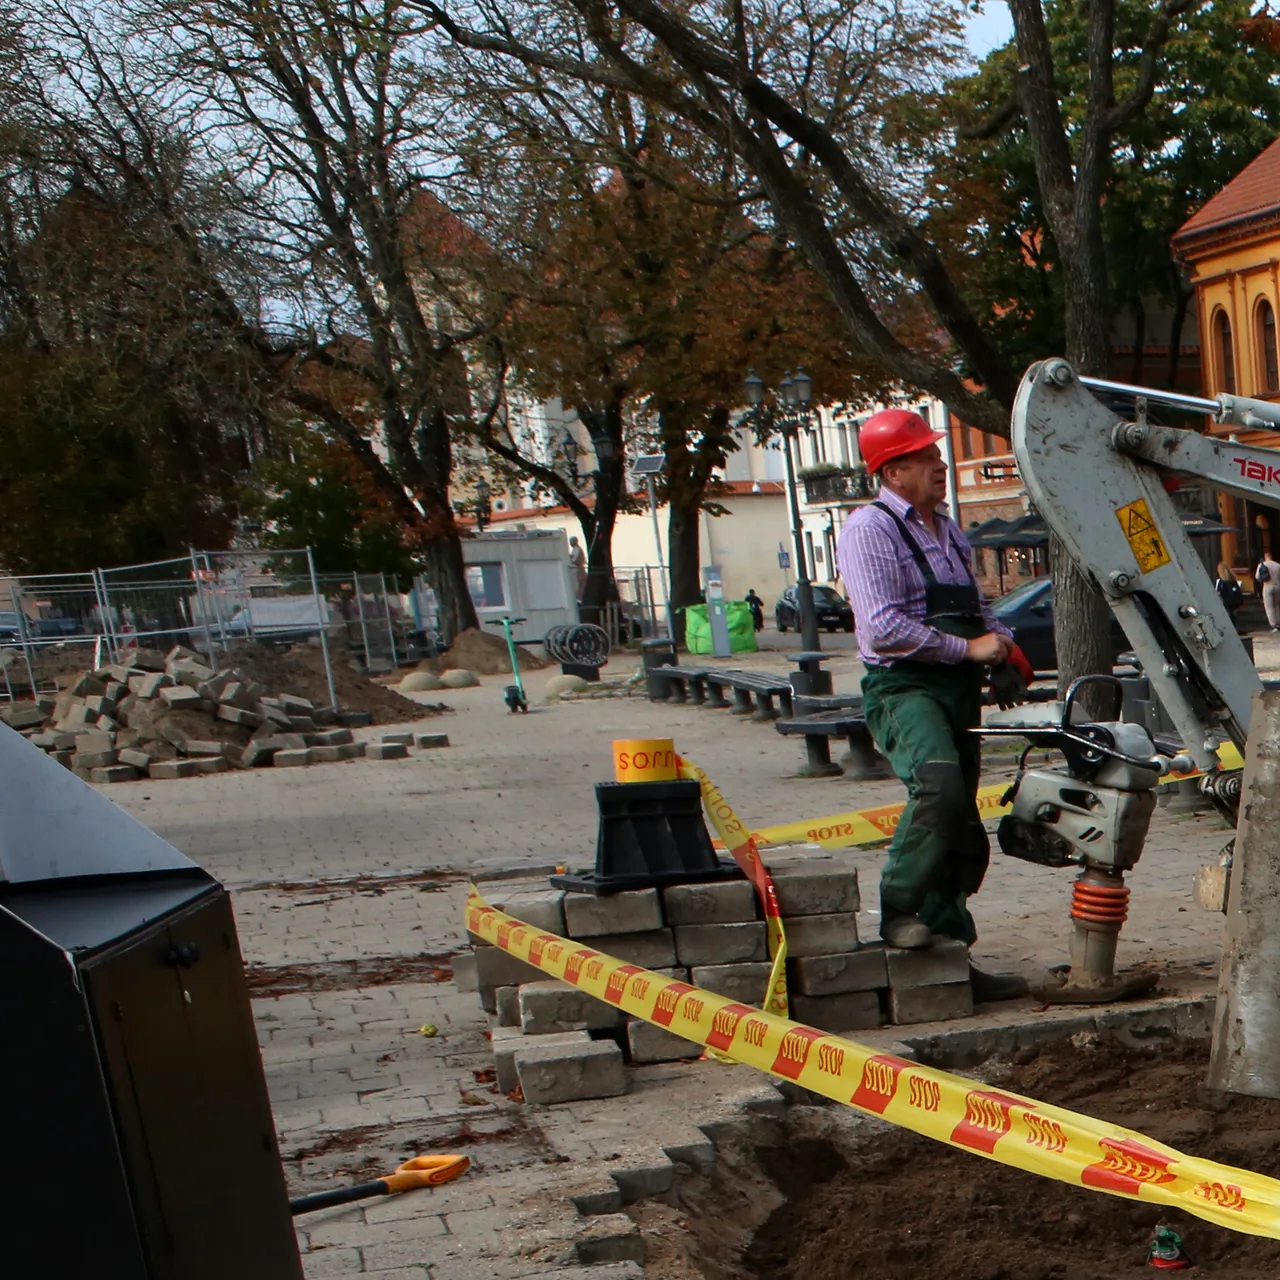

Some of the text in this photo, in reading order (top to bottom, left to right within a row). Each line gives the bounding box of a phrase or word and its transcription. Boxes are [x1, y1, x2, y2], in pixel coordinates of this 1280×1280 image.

[658, 988, 680, 1013] STOP
[683, 996, 704, 1023] STOP
[714, 1008, 739, 1037] STOP
[744, 1018, 769, 1047] STOP
[782, 1031, 809, 1063] STOP
[818, 1043, 845, 1077] STOP
[864, 1059, 894, 1097] STOP
[908, 1074, 941, 1113] STOP
[966, 1093, 1006, 1134] STOP
[1022, 1111, 1069, 1154] STOP
